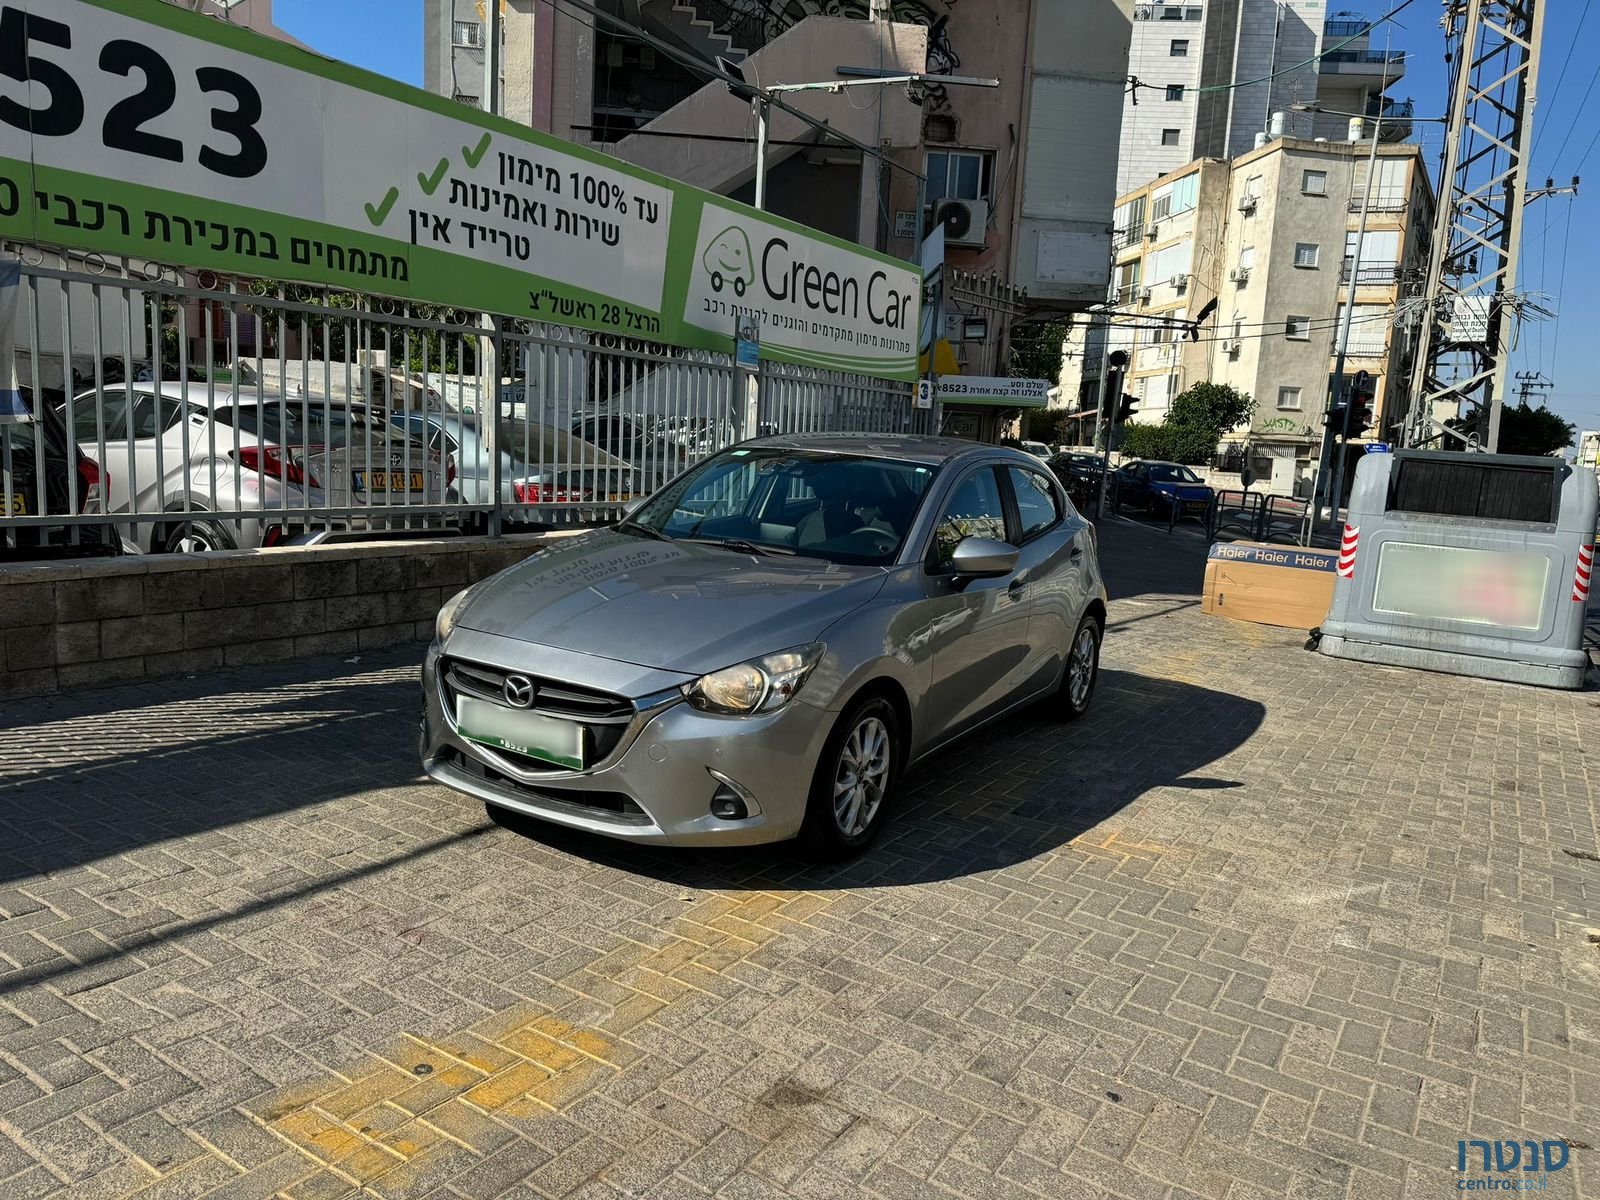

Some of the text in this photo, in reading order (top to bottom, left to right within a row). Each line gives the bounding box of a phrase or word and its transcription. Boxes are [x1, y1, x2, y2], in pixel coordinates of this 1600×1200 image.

[498, 151, 658, 224] עד 100% מימון
[34, 191, 129, 236] רכבי
[449, 178, 620, 247] שירות ואמינות
[144, 210, 279, 260] במכירת
[409, 209, 530, 261] טרייד אין
[291, 237, 408, 281] מתמחים
[762, 237, 912, 330] Green Car
[601, 304, 621, 326] 28
[704, 298, 726, 315] רכב
[625, 307, 660, 333] הרצל
[773, 314, 808, 333] והוגנים
[812, 322, 853, 342] מתקדמים
[856, 332, 877, 346] מימון
[880, 337, 910, 353] פתרונות
[992, 388, 1009, 397] קצת
[1026, 381, 1044, 389] שלם
[1217, 546, 1250, 559] Haier
[1255, 550, 1289, 564] Haier
[1295, 554, 1329, 568] Haier
